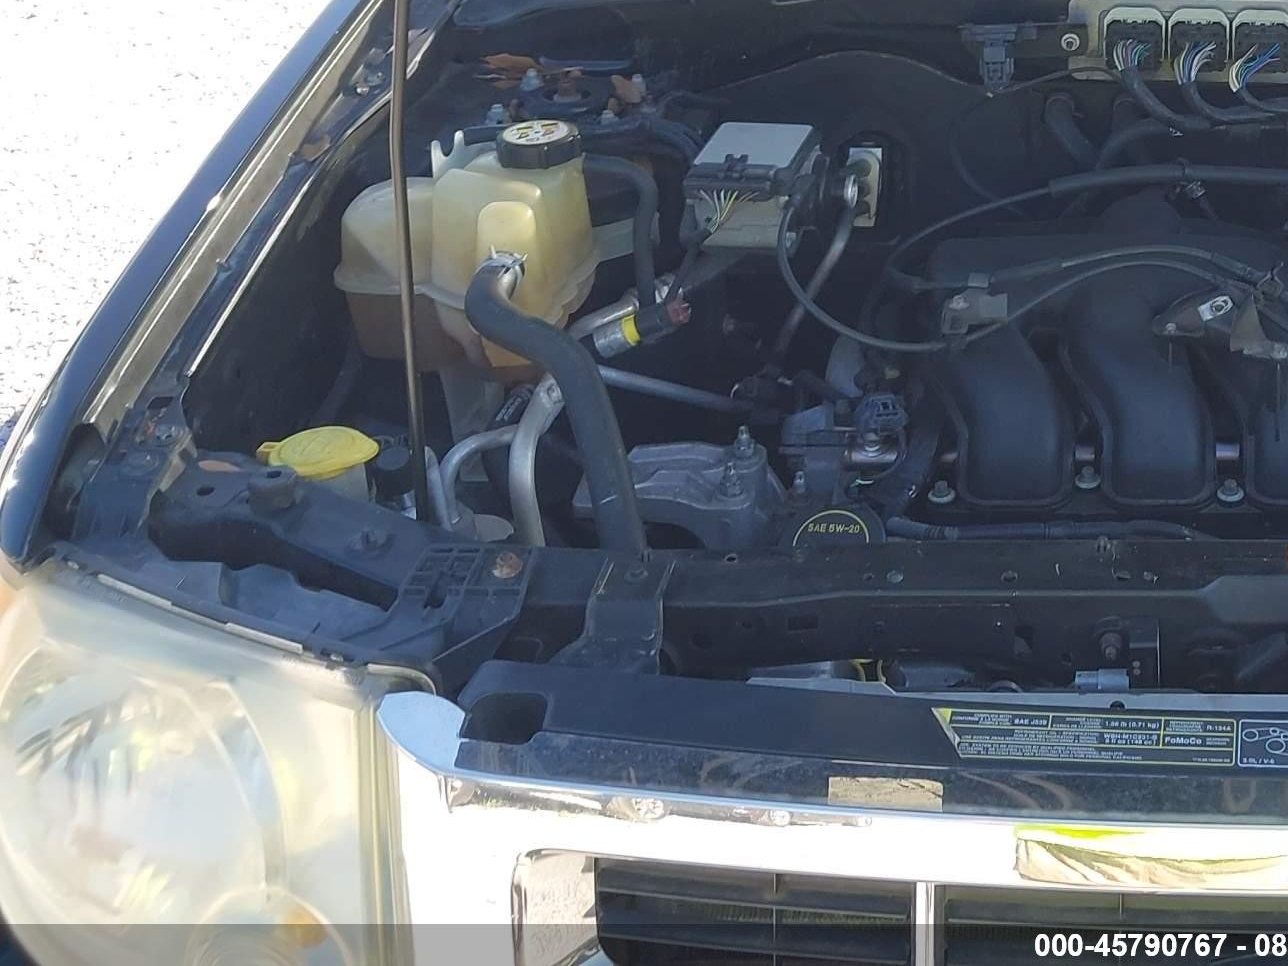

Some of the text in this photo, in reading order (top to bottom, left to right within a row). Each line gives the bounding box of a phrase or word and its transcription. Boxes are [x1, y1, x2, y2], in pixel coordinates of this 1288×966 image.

[808, 523, 860, 533] SAE 5W-20
[1165, 737, 1202, 745] FoMoCo
